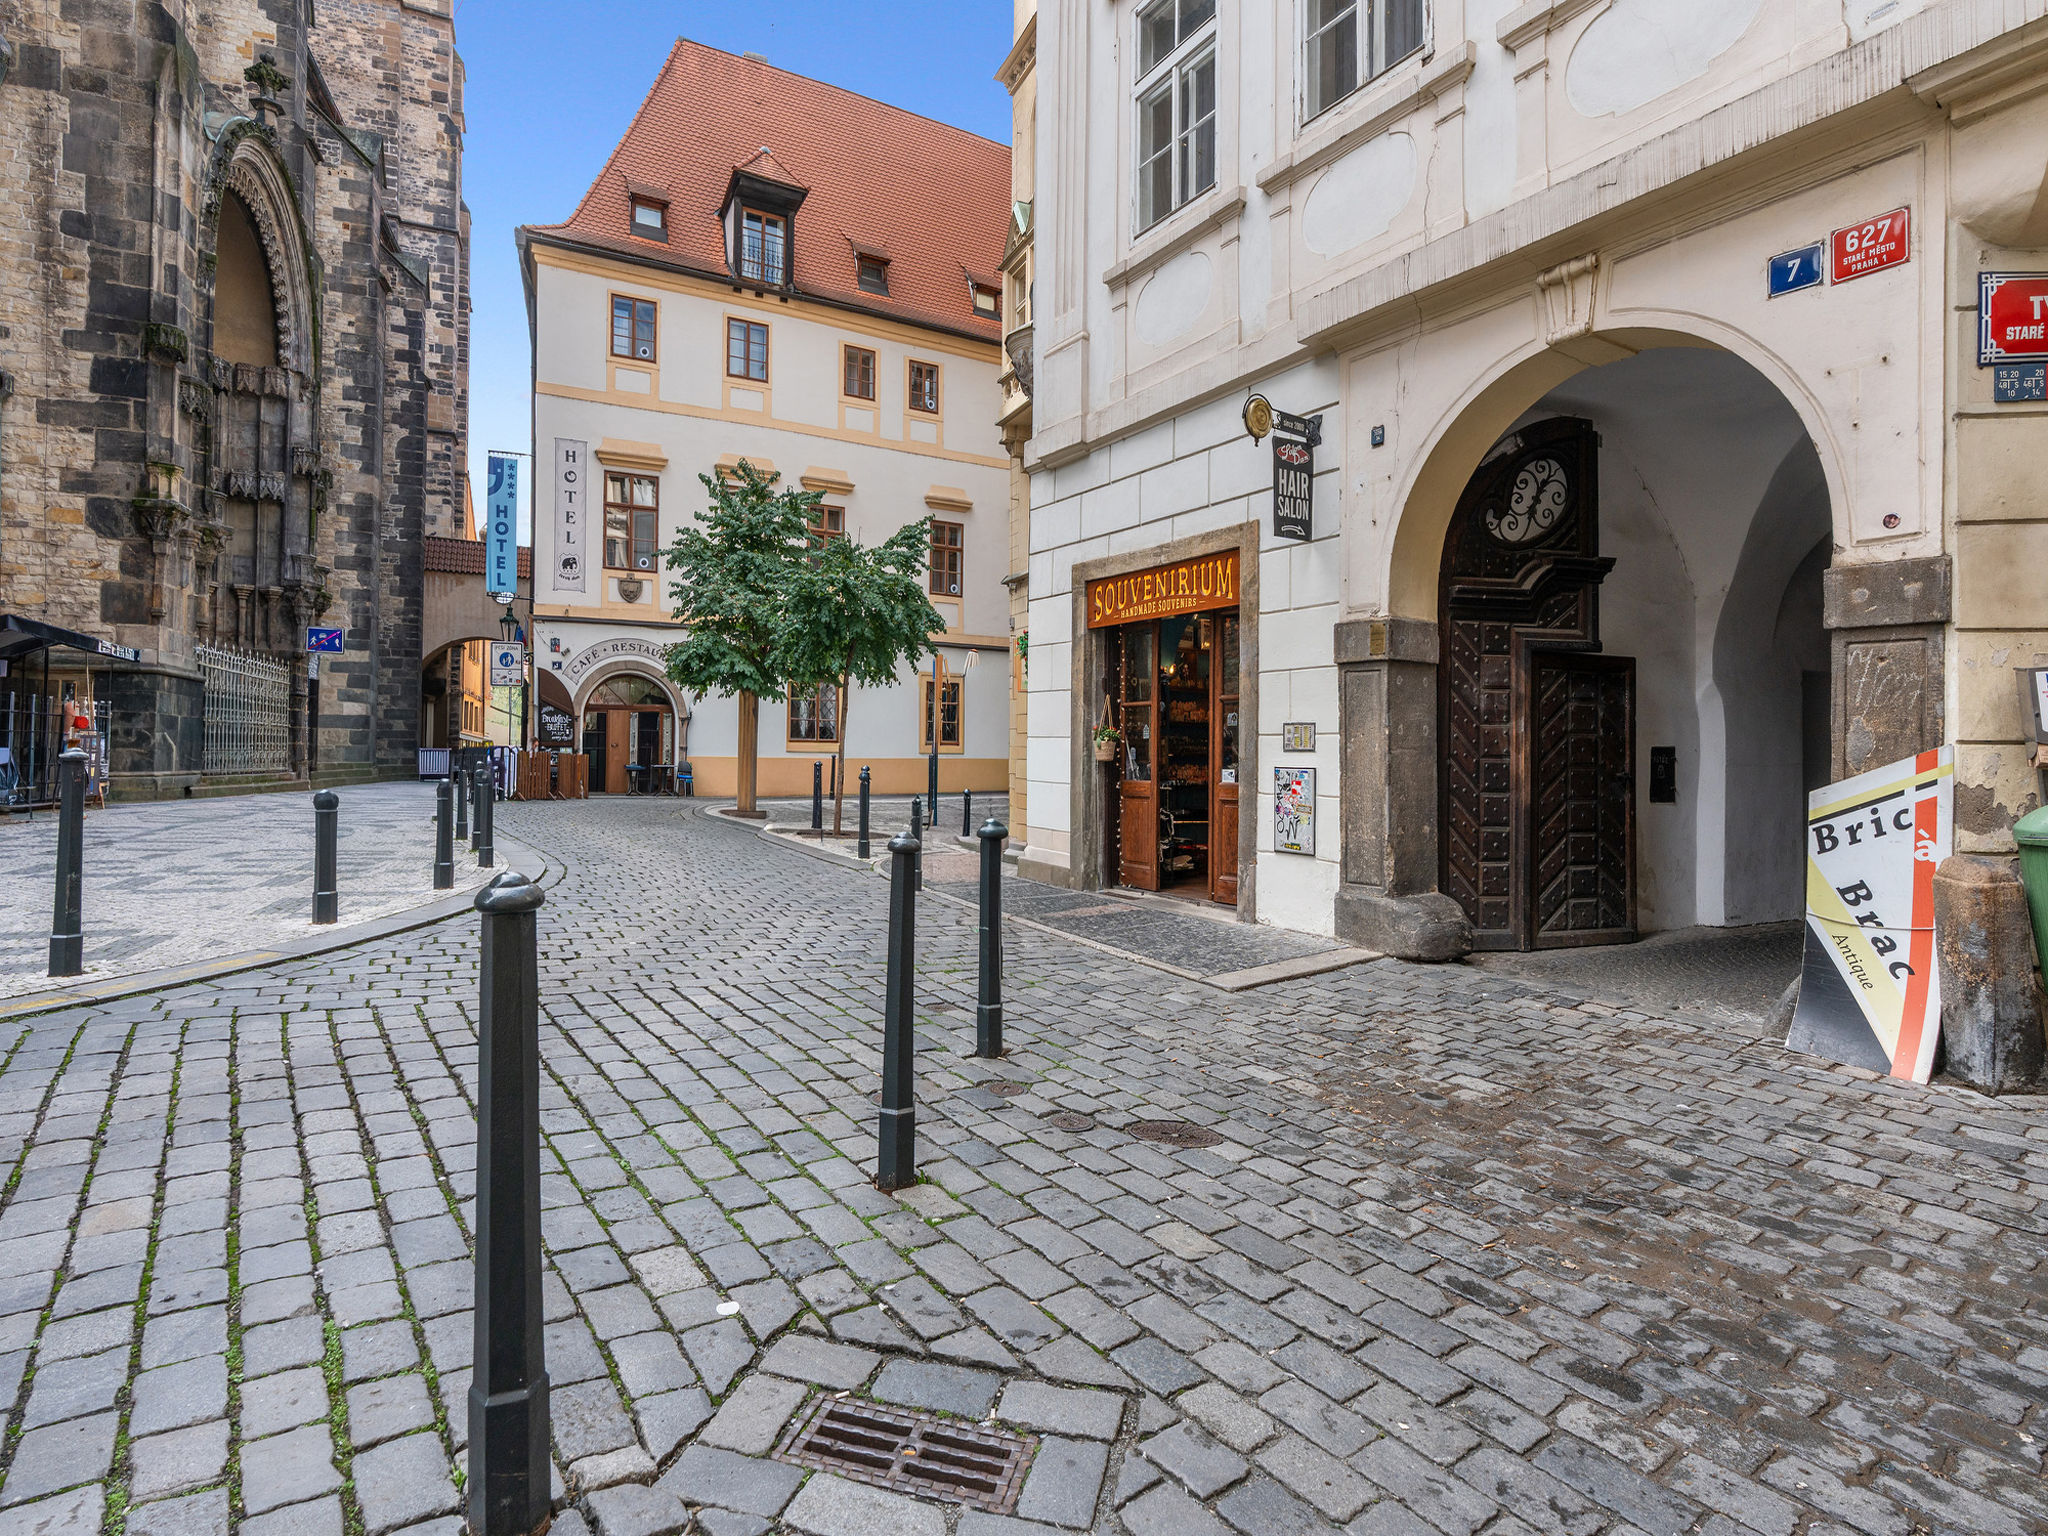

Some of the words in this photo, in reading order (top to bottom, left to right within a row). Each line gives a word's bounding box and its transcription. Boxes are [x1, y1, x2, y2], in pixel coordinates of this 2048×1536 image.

[1845, 218, 1891, 252] 627
[1843, 249, 1865, 265] STARÉ
[1869, 242, 1895, 257] MĚSTO
[1851, 257, 1879, 272] PRAHA
[1882, 254, 1887, 263] 1
[1787, 258, 1801, 282] 7
[2006, 322, 2045, 340] STARÉ
[1999, 370, 2008, 378] 15
[2010, 370, 2019, 378] 20
[2007, 389, 2016, 397] 10
[563, 450, 577, 544] HOTEL
[1278, 468, 1310, 499] HAIR
[1278, 496, 1309, 521] SALON
[495, 504, 509, 586] HOTEL
[1094, 557, 1233, 622] SOUVENIRIUM
[1120, 602, 1156, 618] HANDMADE
[1157, 597, 1197, 612] SOUVENIRS
[571, 647, 600, 675] CAFÉ
[611, 642, 668, 661] RESTAUR
[1812, 807, 1913, 855] Bric
[1914, 828, 1937, 862] à
[1836, 879, 1915, 980] Brac
[1832, 934, 1874, 990] Antique
